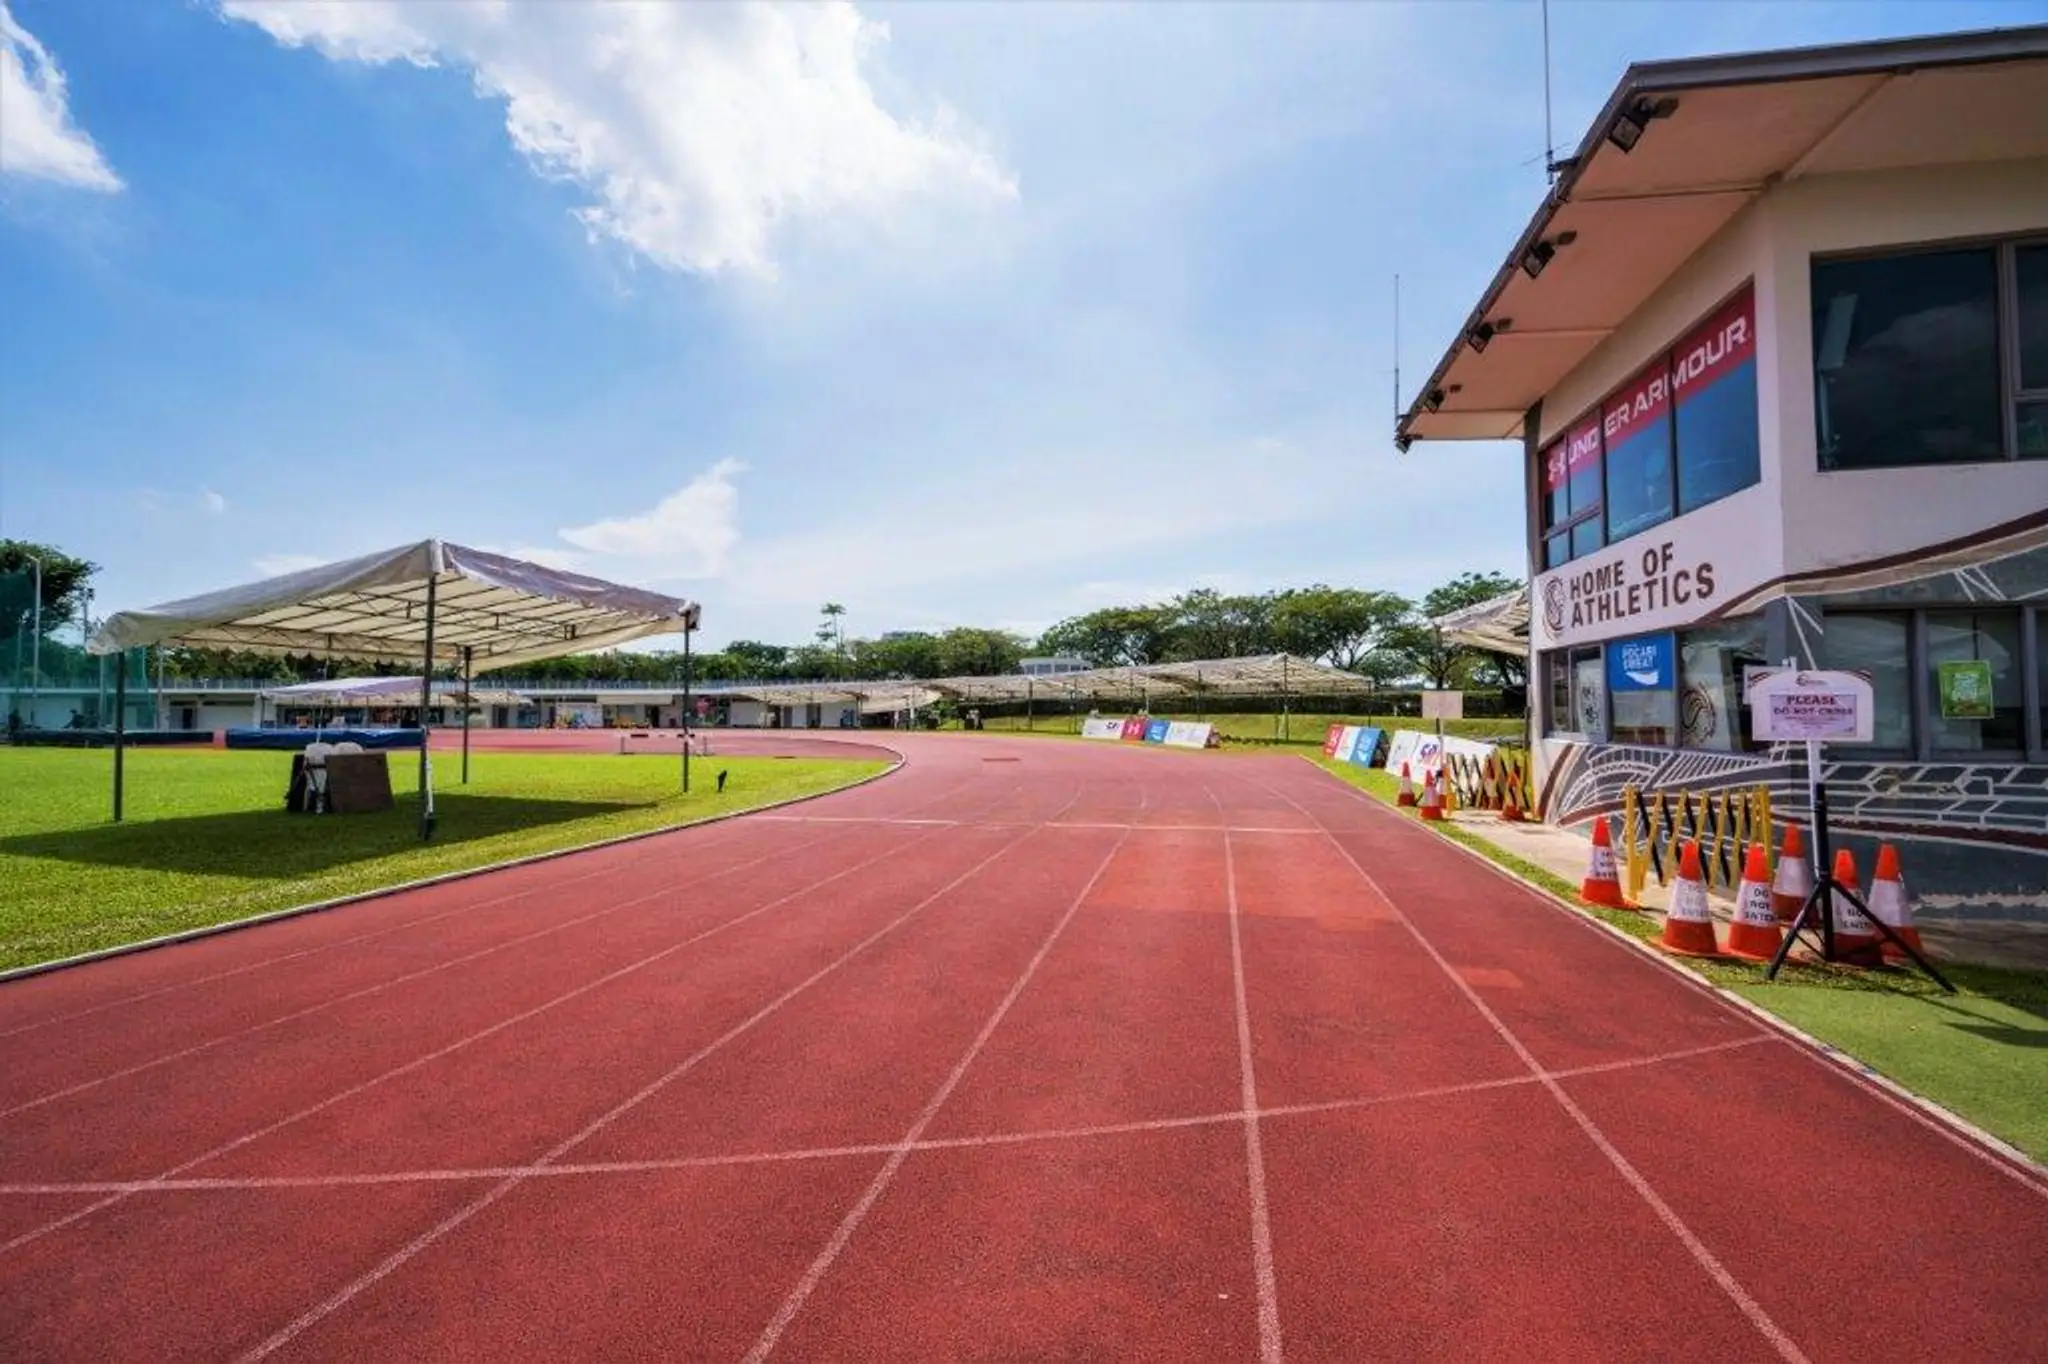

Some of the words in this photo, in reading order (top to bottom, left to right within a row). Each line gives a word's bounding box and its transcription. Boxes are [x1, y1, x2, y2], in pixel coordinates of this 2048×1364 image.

[1568, 403, 1630, 465] UNDER
[1570, 560, 1624, 599] HOME
[1642, 542, 1674, 578] OF
[1571, 562, 1715, 629] ATHLETICS
